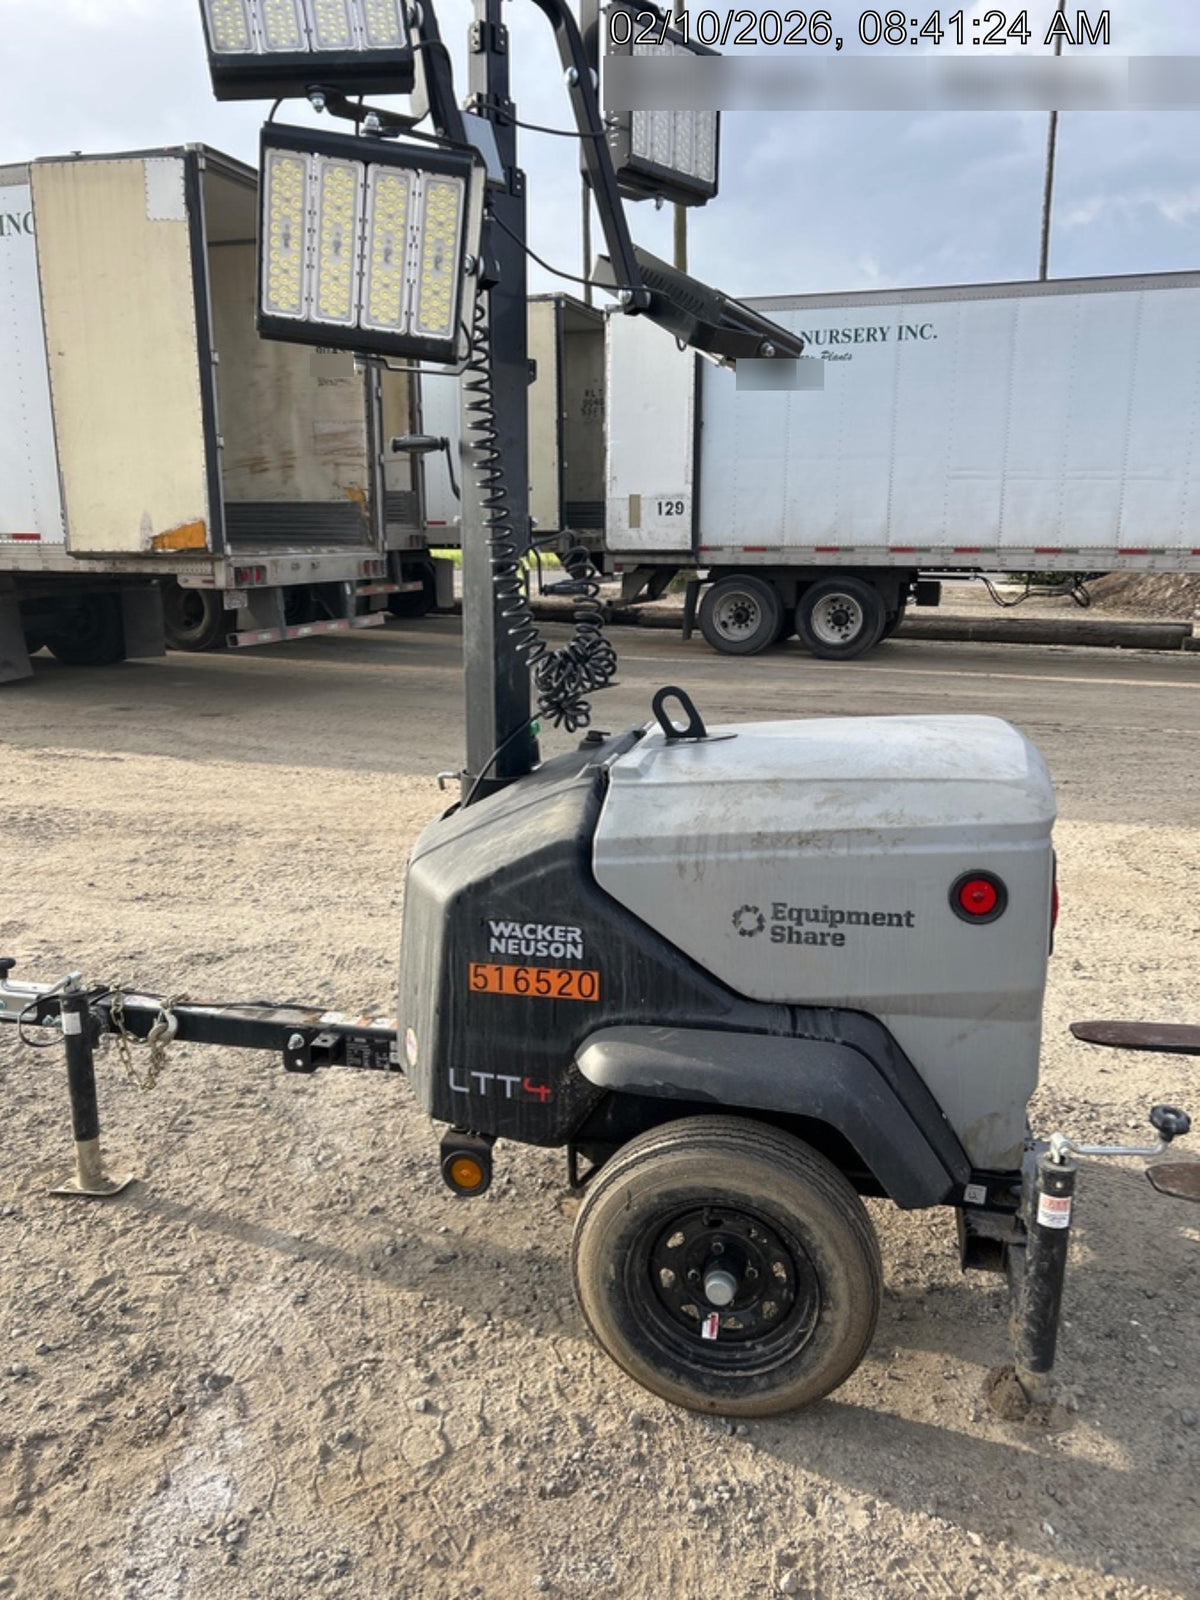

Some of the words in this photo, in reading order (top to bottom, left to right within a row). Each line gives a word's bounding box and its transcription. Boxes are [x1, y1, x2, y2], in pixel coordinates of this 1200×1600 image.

[801, 326, 890, 346] NURSERY
[897, 323, 938, 341] INC.
[657, 501, 685, 516] 129
[771, 902, 915, 928] Equipment
[488, 920, 583, 943] WACKER
[770, 924, 846, 947] Share
[489, 938, 584, 960] NEUSON
[472, 965, 596, 999] 516520
[449, 1067, 552, 1102] LTT4
